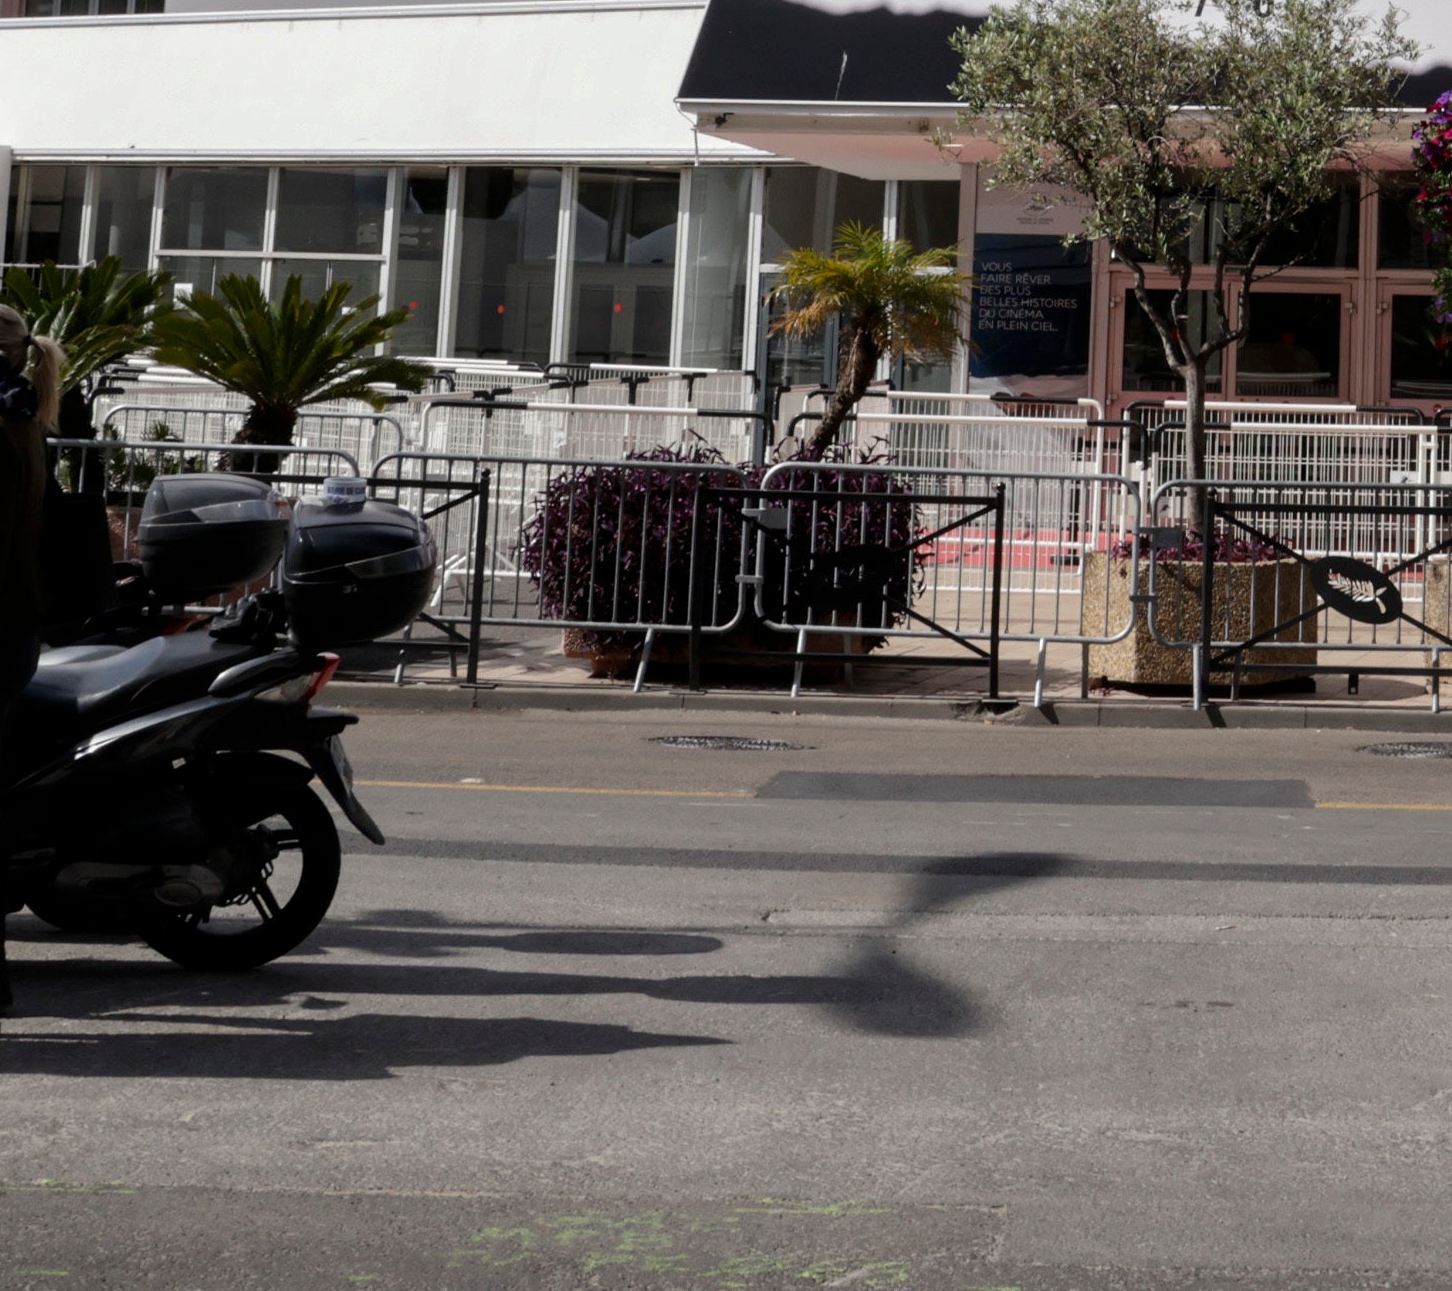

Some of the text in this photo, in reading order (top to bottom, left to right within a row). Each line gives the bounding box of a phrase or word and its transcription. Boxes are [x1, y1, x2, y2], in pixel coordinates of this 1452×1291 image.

[981, 261, 1012, 272] VOUS
[981, 272, 1051, 285] FAIRE RÊVER
[980, 285, 1031, 296] DES PLUS
[979, 296, 1078, 309] BELLES HISTOIRES
[979, 308, 996, 318] DU
[978, 320, 1059, 332] EN PLEIN CIEL.
